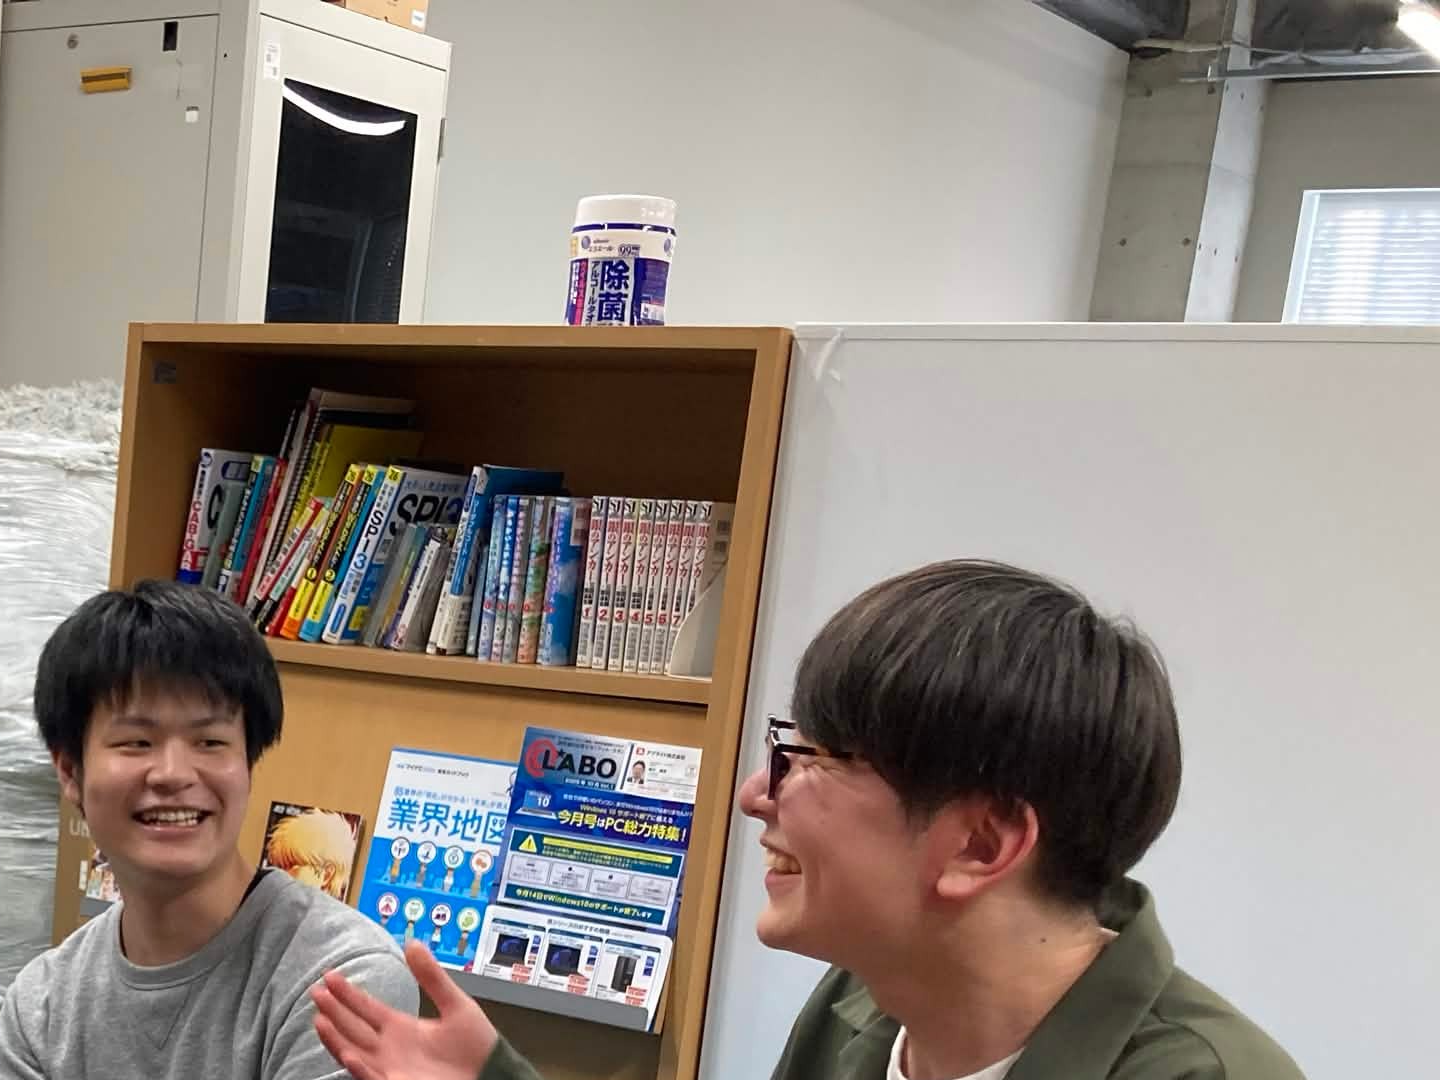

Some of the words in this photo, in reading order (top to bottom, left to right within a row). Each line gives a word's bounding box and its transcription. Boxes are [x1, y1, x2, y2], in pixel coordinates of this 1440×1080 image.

[598, 260, 629, 322] 除菌
[354, 510, 384, 569] SPI3
[583, 608, 590, 618] 1
[599, 610, 607, 621] 2
[615, 610, 623, 621] 3
[631, 611, 639, 622] 4
[644, 613, 653, 625] 5
[657, 613, 667, 625] 6
[672, 615, 681, 626] 7
[537, 796, 550, 808] 10
[388, 798, 508, 846] 業界地図
